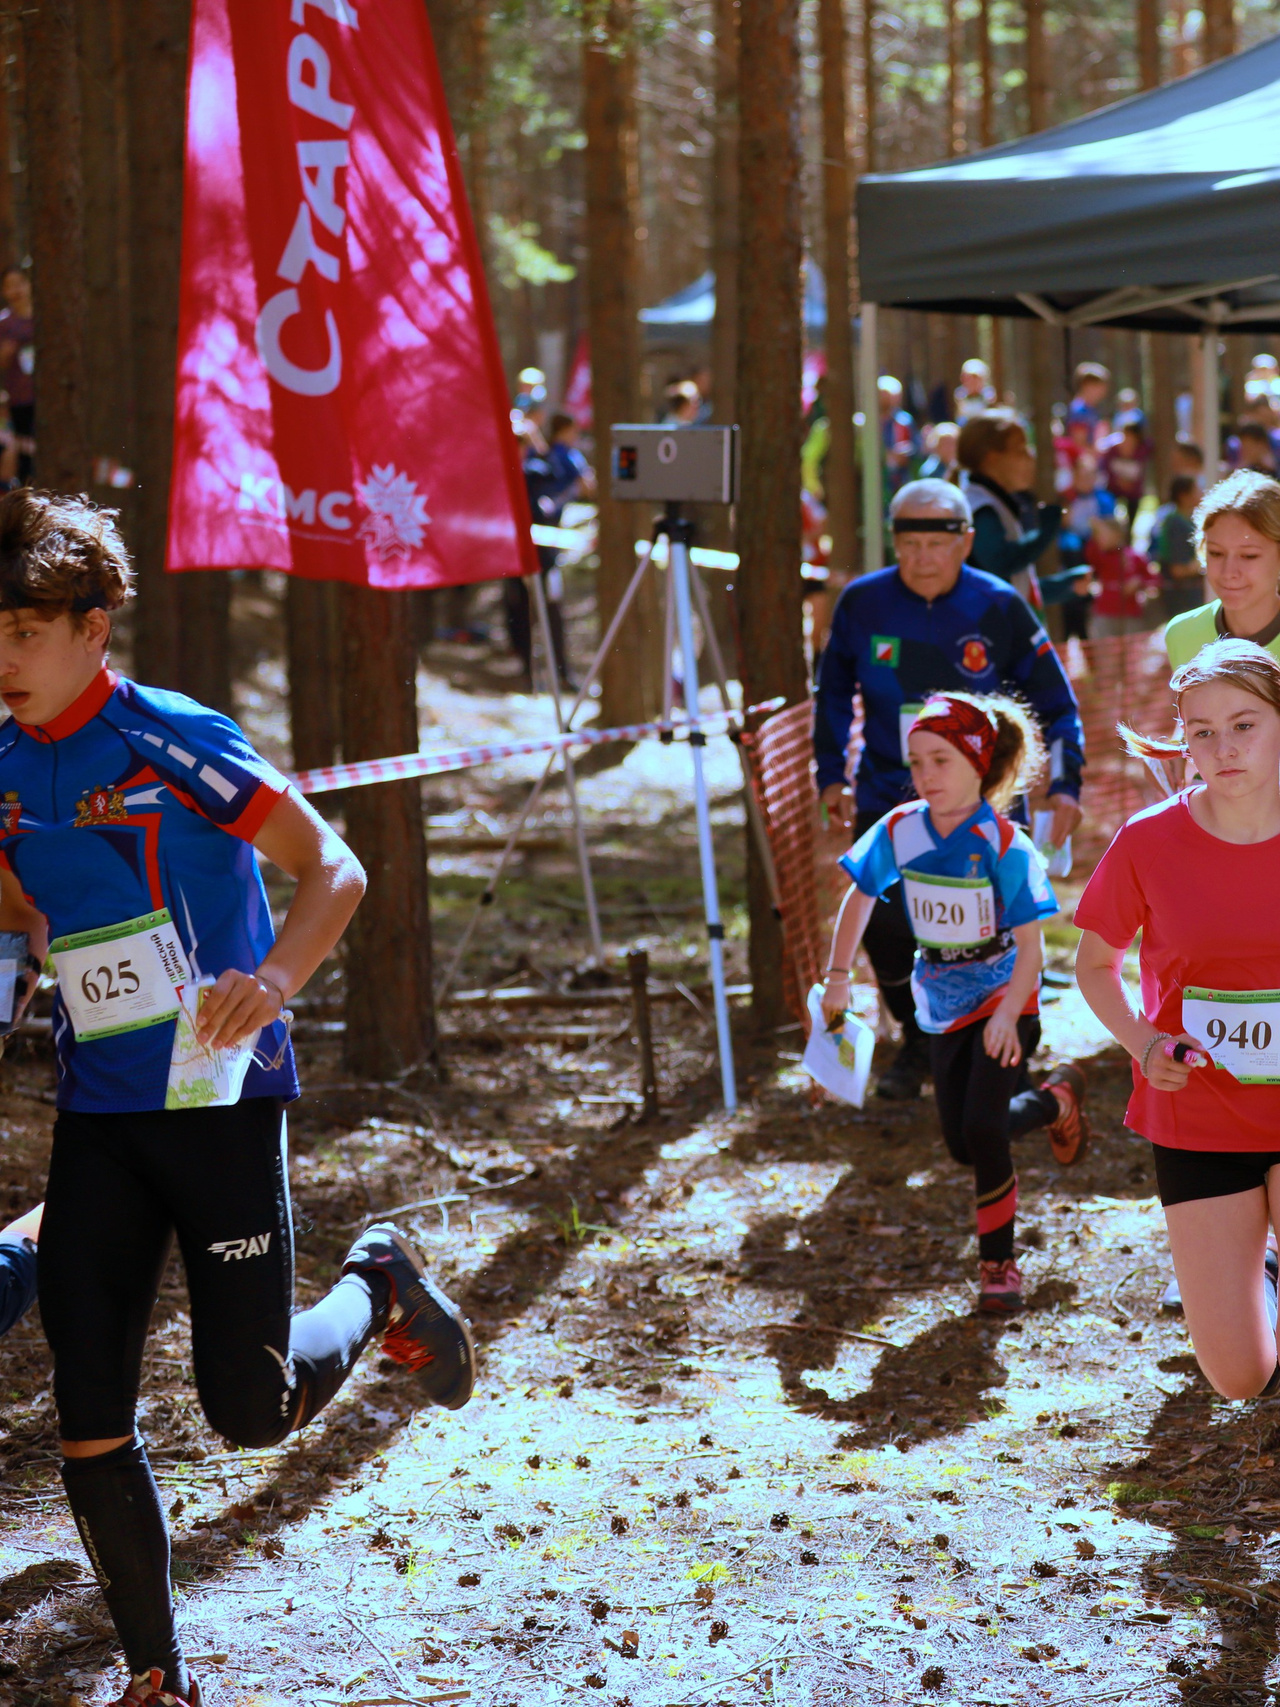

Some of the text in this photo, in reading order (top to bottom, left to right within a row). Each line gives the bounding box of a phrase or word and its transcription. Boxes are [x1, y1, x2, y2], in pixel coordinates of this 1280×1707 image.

[912, 897, 965, 926] 1020
[150, 933, 178, 983] ПЕРМСКИЙ
[165, 941, 186, 980] ПЕРИОД
[81, 959, 140, 1004] 625
[1206, 1018, 1272, 1050] 940
[207, 1231, 272, 1262] RAY
[80, 1515, 103, 1570] NORD
